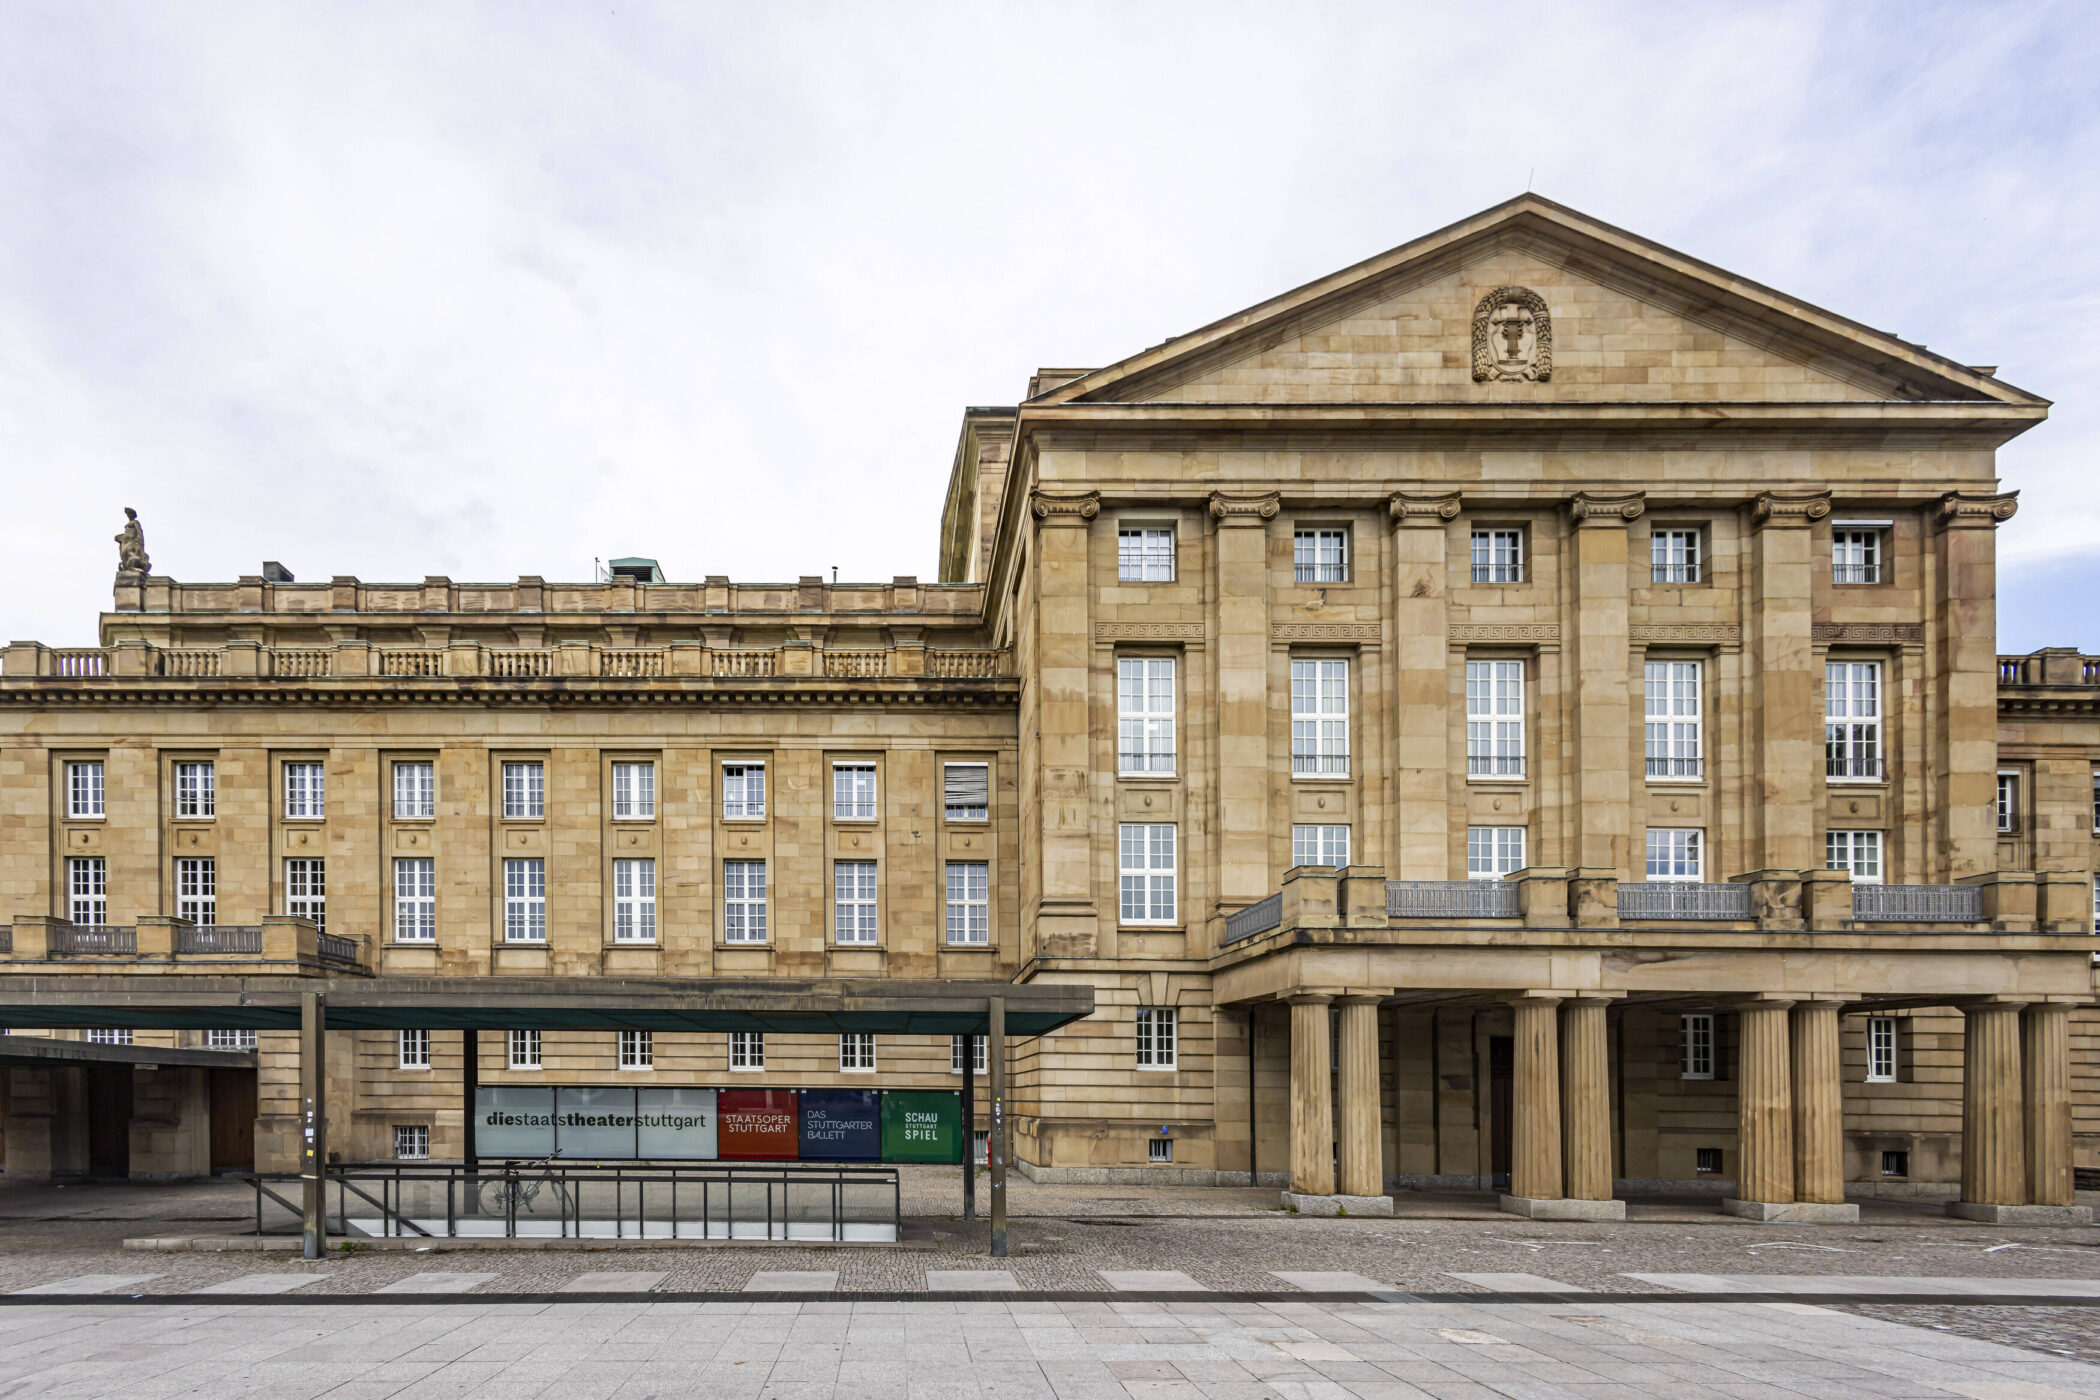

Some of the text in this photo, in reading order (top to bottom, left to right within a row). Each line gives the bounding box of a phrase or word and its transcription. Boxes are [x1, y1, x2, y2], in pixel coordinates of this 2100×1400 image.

[725, 1114, 791, 1124] STAATSOPER
[807, 1110, 826, 1119] DAS
[905, 1112, 938, 1123] SCHAU
[729, 1124, 787, 1133] STUTTGART
[807, 1121, 873, 1130] STUTTGARTER
[807, 1131, 846, 1140] BALLETT
[905, 1129, 938, 1140] SPIEL
